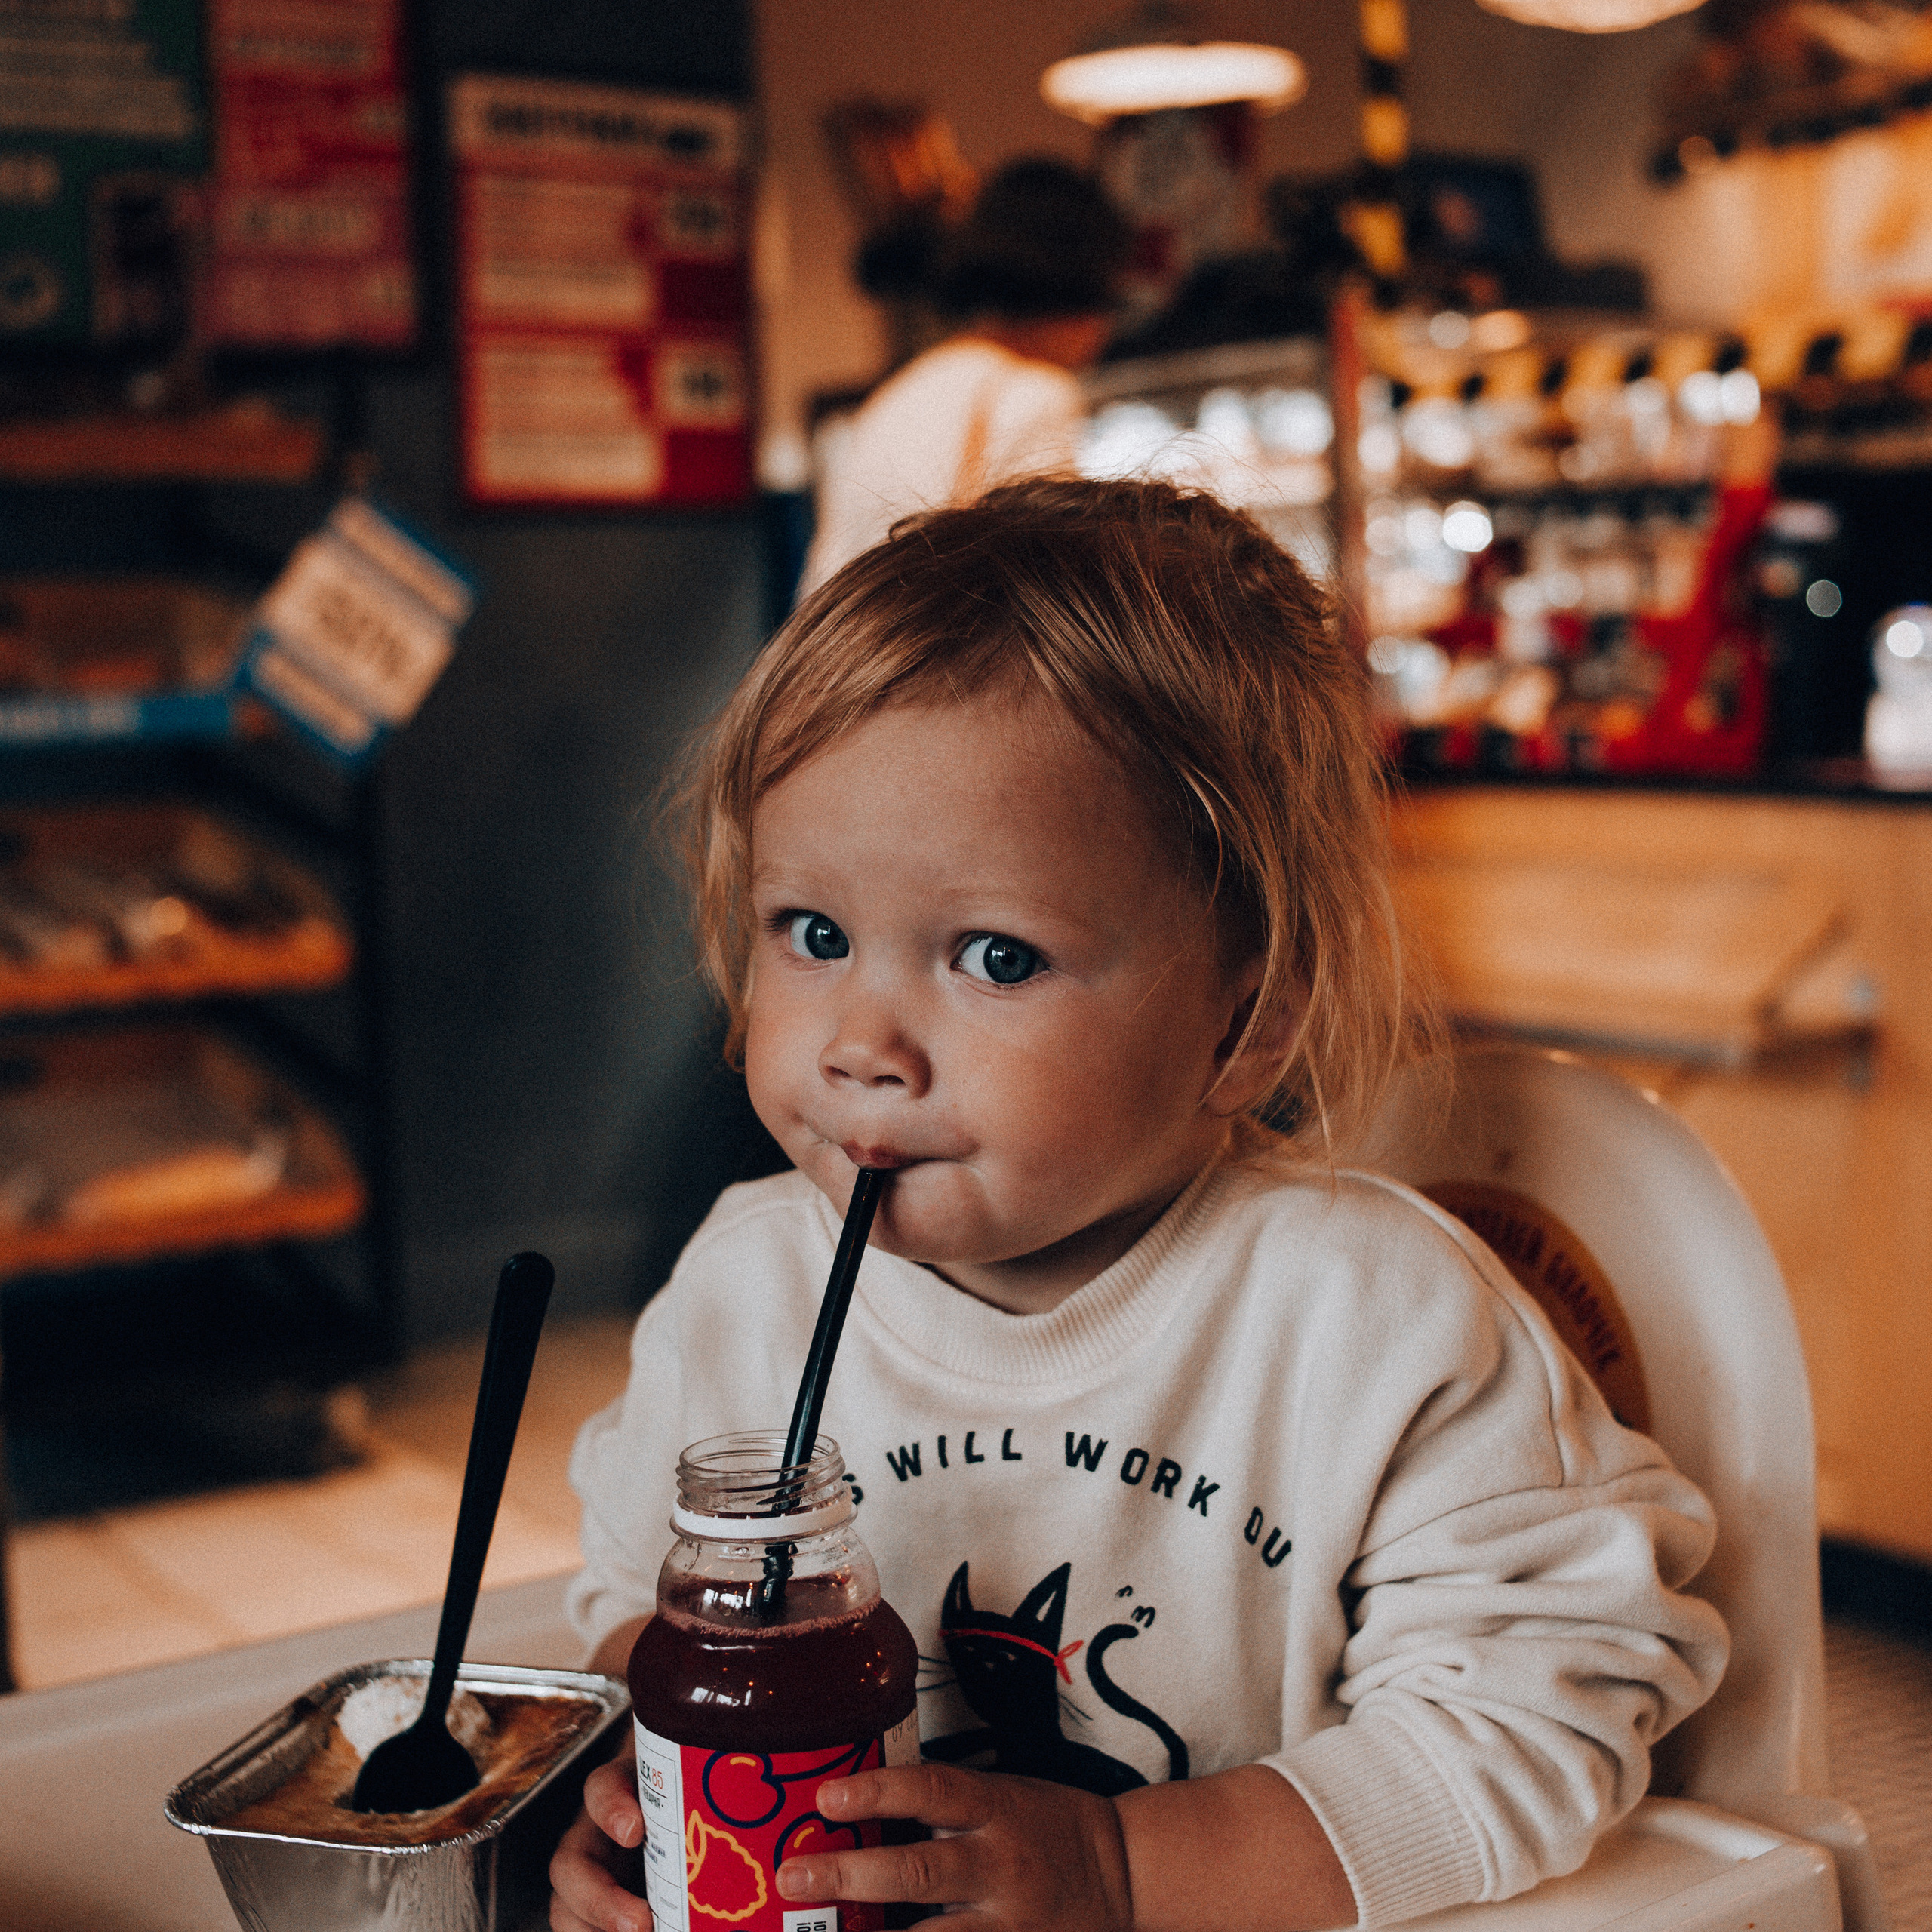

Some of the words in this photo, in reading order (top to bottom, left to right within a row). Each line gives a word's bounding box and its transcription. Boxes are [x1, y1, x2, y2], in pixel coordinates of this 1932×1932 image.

[885, 1428, 1023, 1482] WILL
[1064, 1431, 1220, 1517] WORK
[1244, 1506, 1292, 1568] OU
